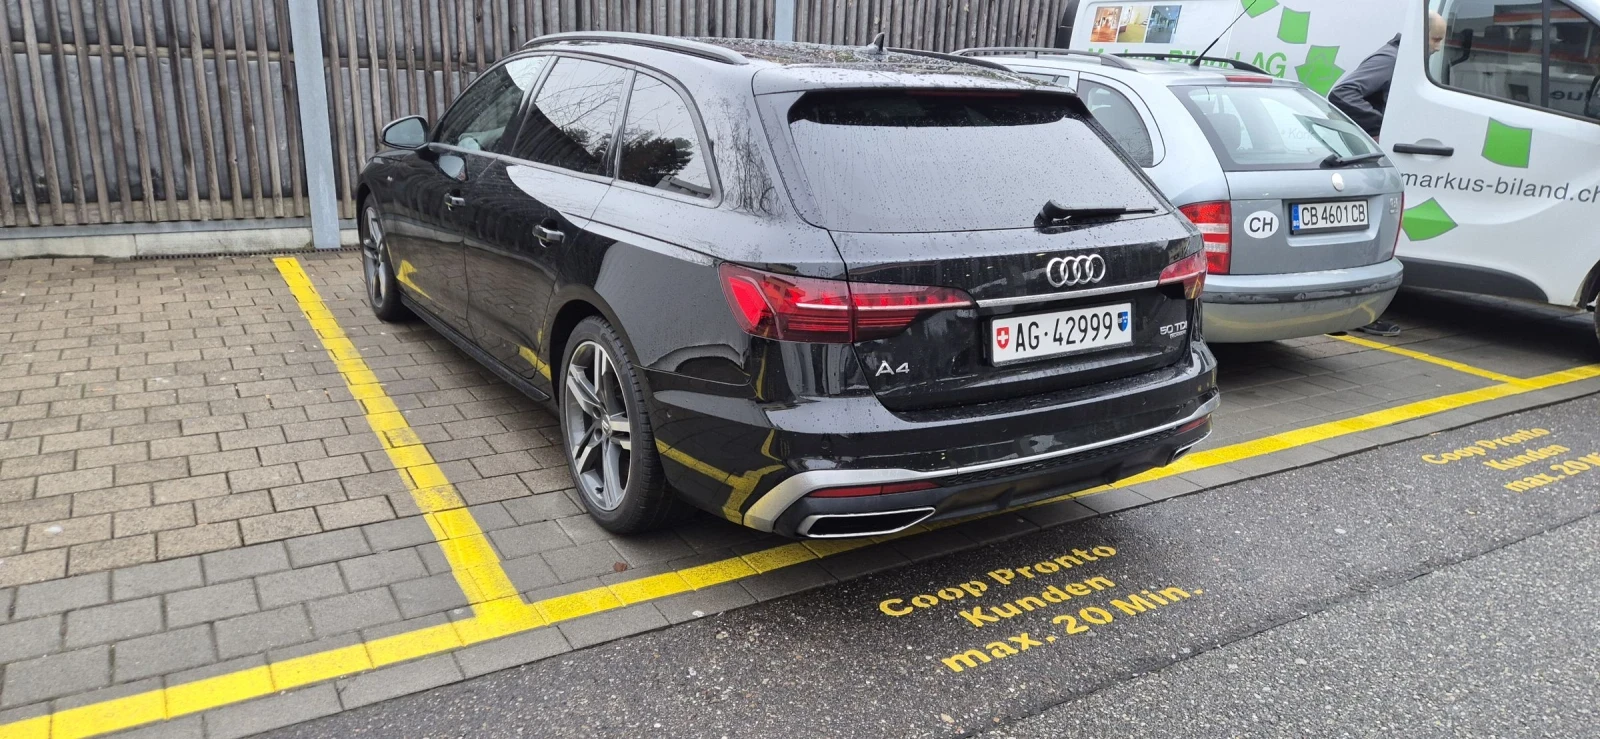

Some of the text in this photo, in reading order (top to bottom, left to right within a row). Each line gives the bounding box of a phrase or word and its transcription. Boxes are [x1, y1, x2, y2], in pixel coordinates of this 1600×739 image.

[1251, 52, 1287, 78] AG
[1250, 217, 1273, 233] CH
[1301, 206, 1319, 226] CB
[1321, 204, 1349, 225] 4601
[1351, 203, 1366, 223] CB
[1160, 325, 1174, 335] 50
[1174, 320, 1188, 331] TDI
[875, 360, 910, 377] A4
[1422, 428, 1550, 465] Coop Pronto
[1483, 444, 1570, 471] Kunden
[1504, 472, 1565, 493] max.
[1550, 460, 1591, 476] 20
[879, 545, 1117, 617] Coop Pronto
[960, 576, 1116, 627] Kunden
[941, 585, 1204, 672] max. 20 Min.
